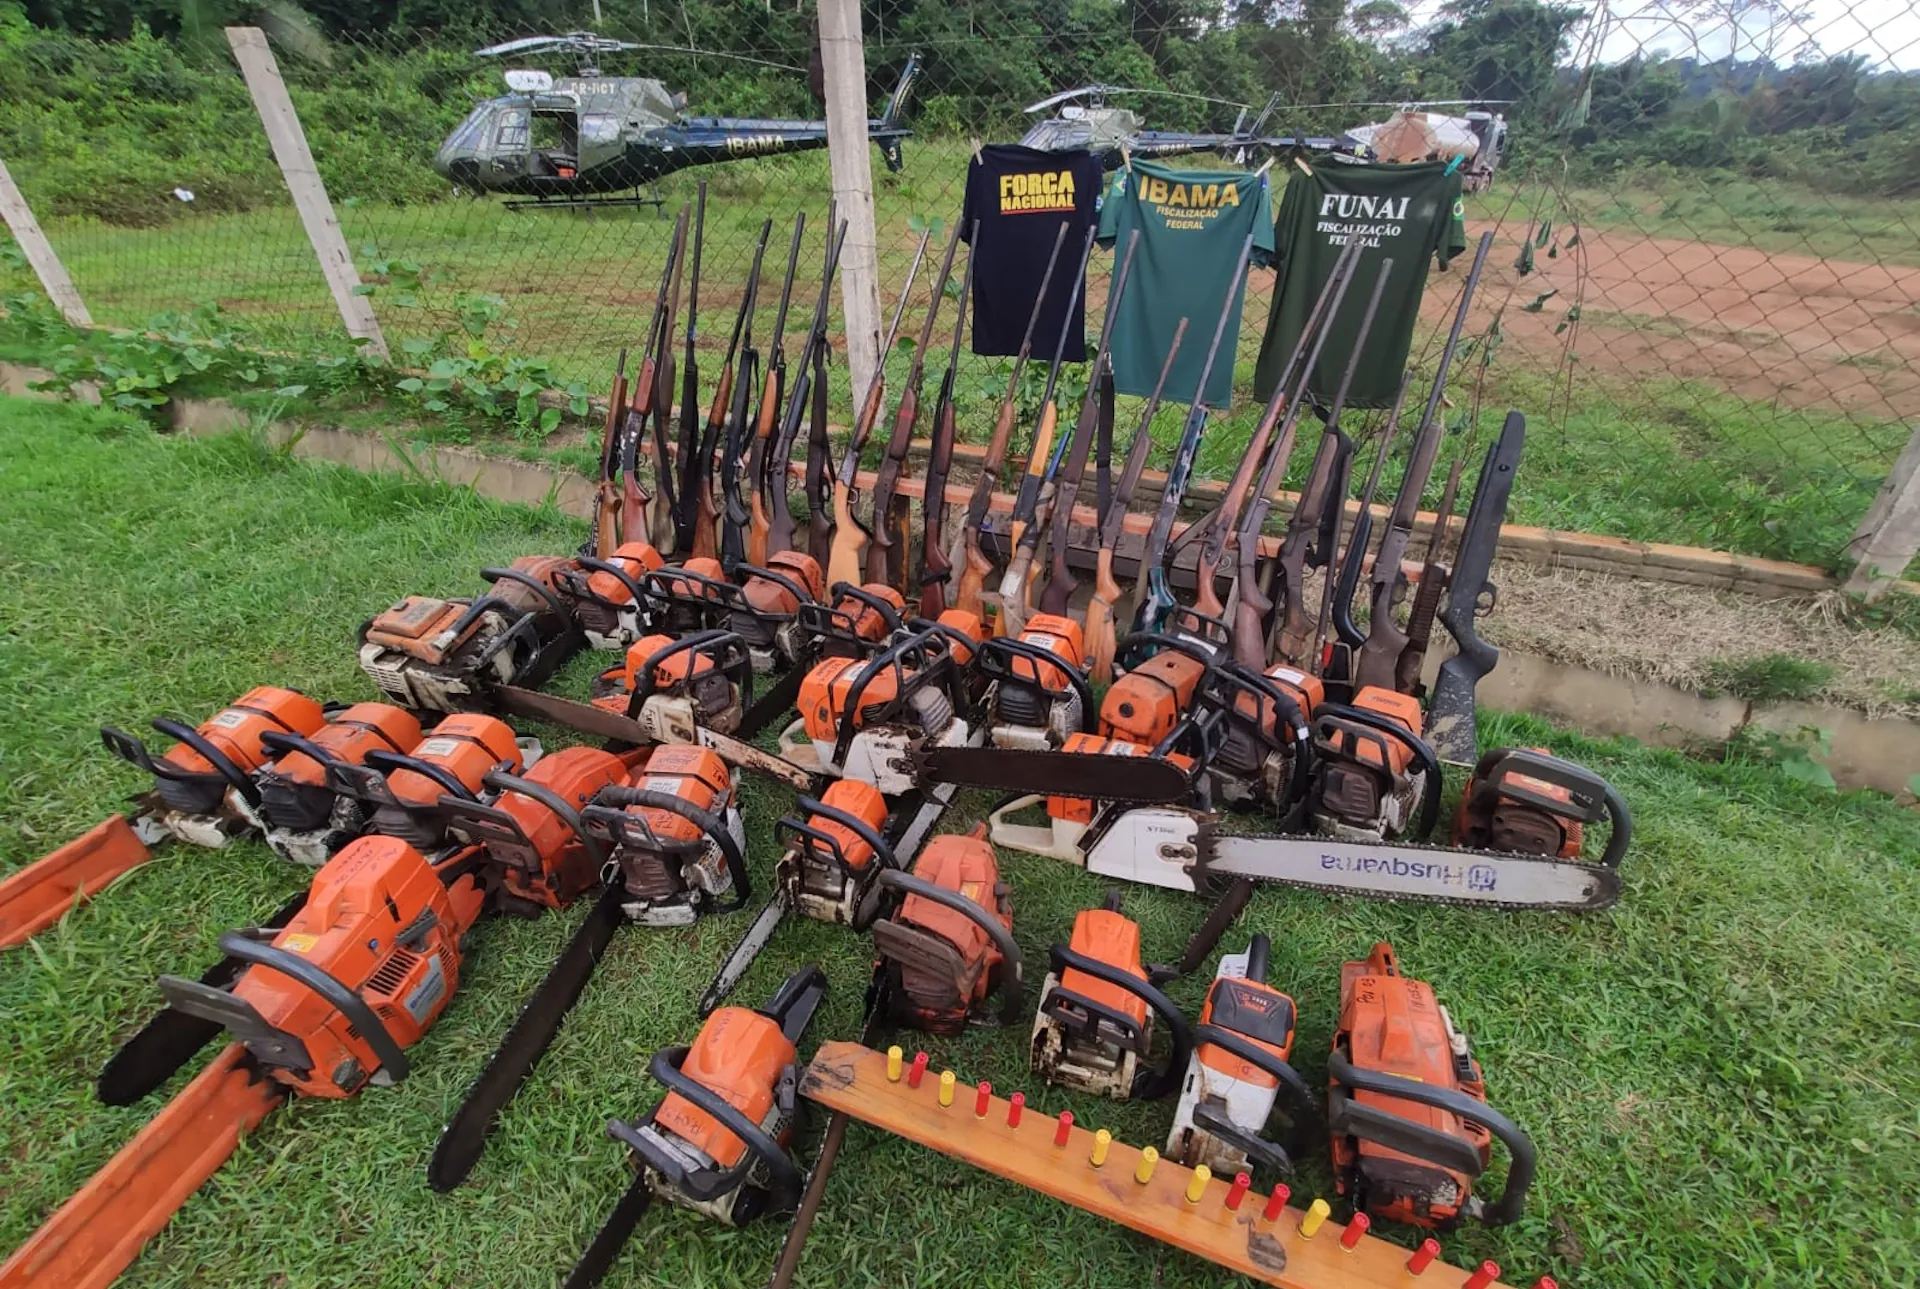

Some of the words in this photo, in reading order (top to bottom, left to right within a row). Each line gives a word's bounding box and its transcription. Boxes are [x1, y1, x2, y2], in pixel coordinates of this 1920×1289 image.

[727, 135, 785, 153] IBAMA
[1000, 193, 1075, 211] NACIONAL
[1138, 175, 1240, 208] IBAMA
[1319, 194, 1411, 220] FUNAI
[1165, 219, 1205, 230] FEDERAL
[1320, 853, 1463, 886] Husqvarna
